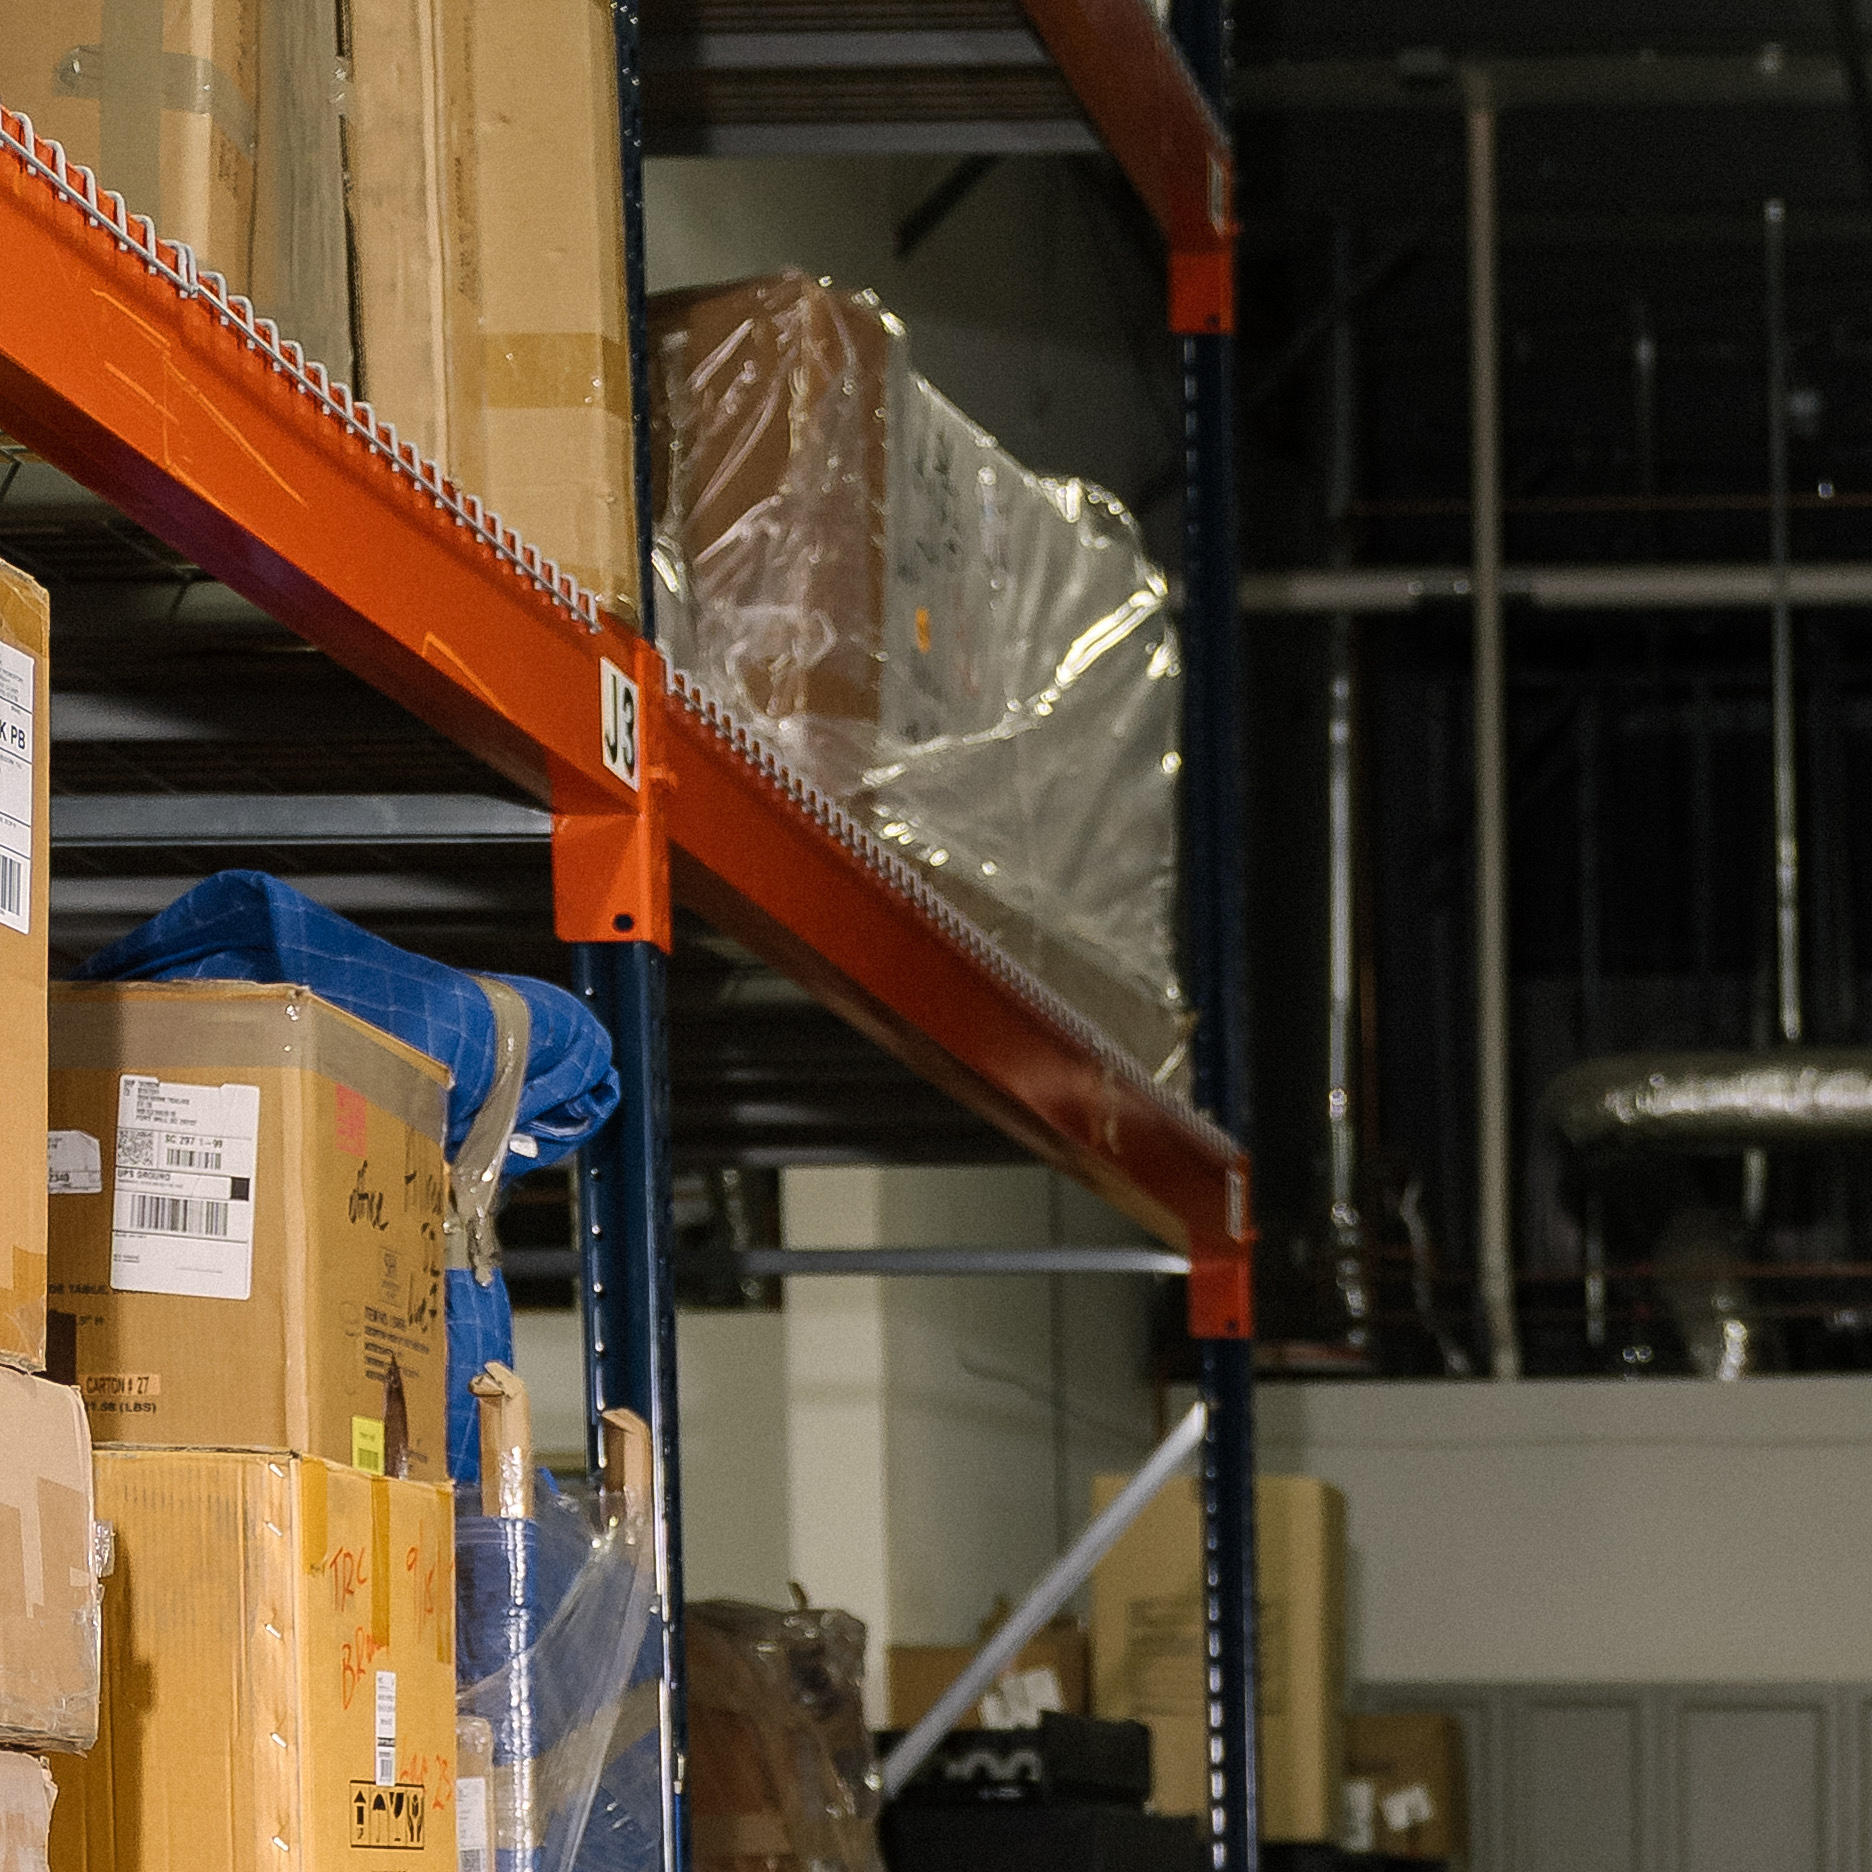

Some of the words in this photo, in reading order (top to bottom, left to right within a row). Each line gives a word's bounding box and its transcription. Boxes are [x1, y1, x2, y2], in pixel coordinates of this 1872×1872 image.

[605, 672, 636, 779] J3
[117, 1168, 136, 1180] UPS
[137, 1170, 171, 1182] GROUND
[86, 1376, 126, 1395] CARTON
[136, 1375, 150, 1394] 27
